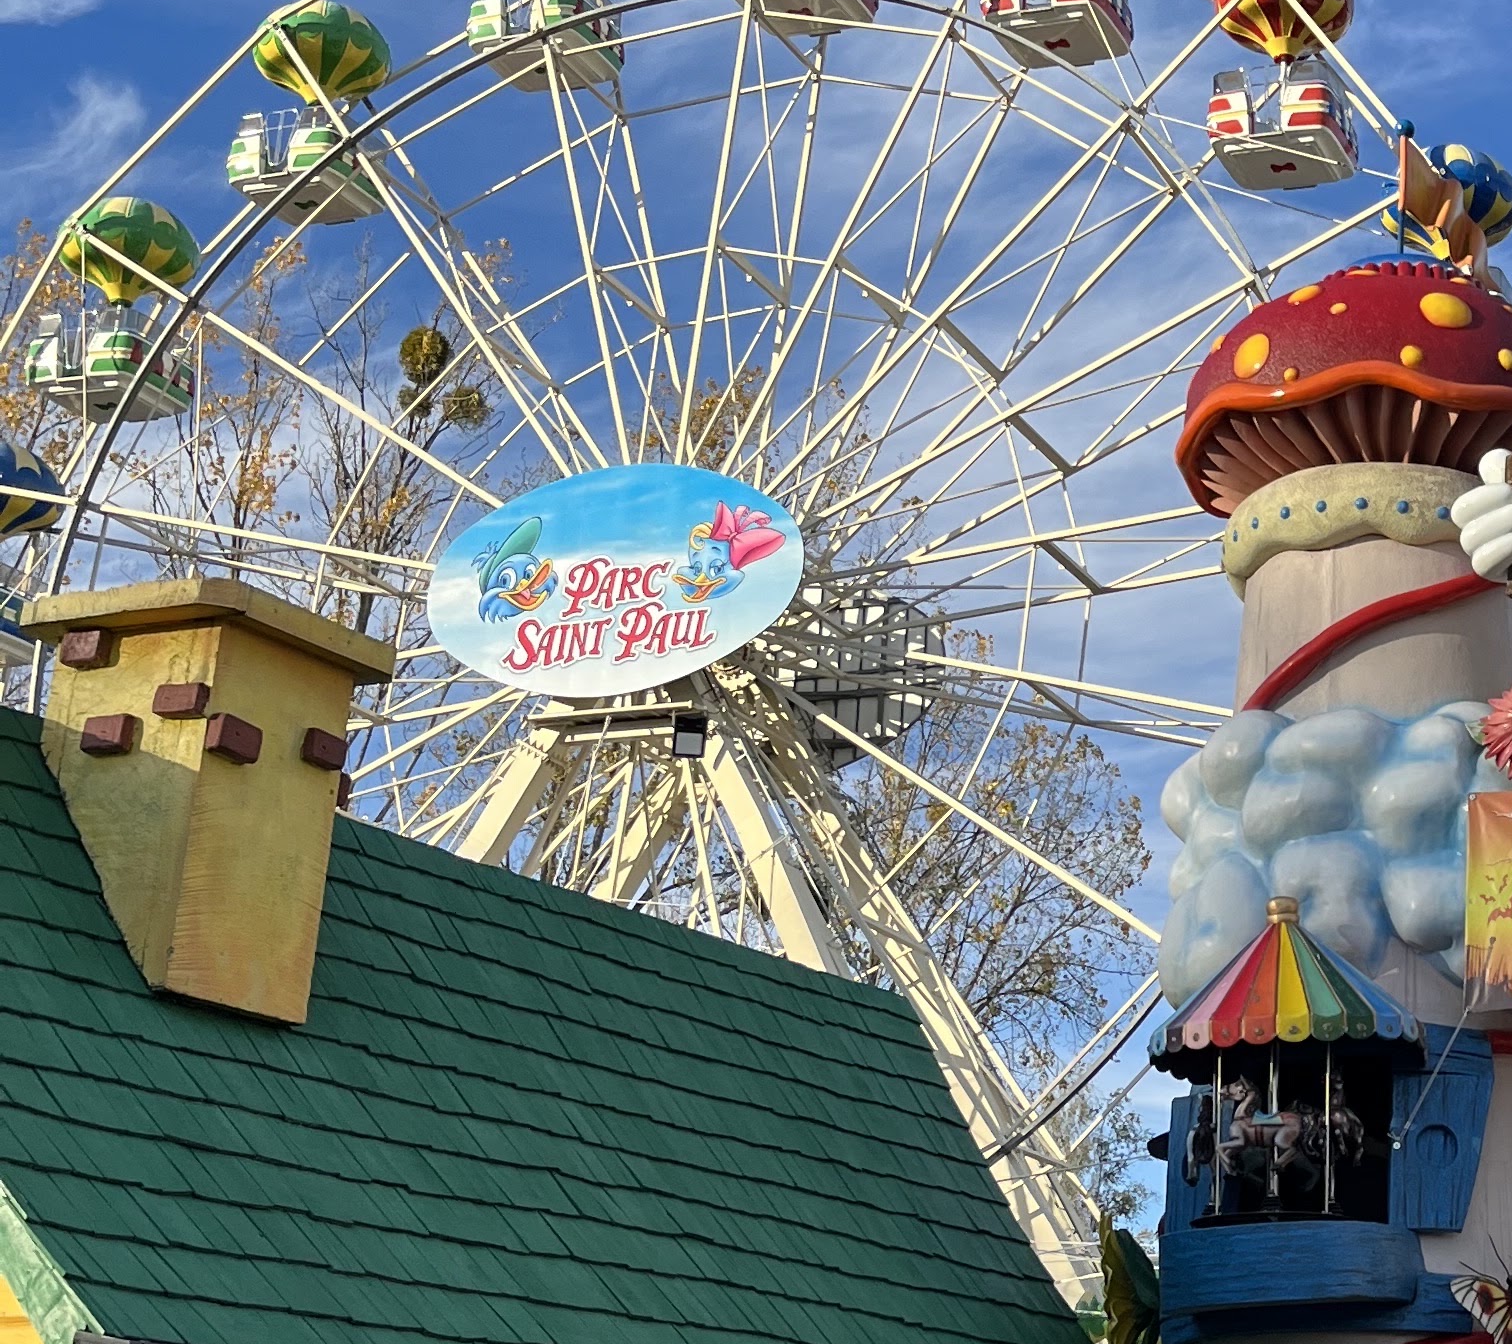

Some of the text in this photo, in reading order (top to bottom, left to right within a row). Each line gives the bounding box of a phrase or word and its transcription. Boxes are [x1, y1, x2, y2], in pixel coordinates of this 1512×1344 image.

[563, 559, 670, 617] PARC
[502, 602, 714, 670] SAINT PAUL
